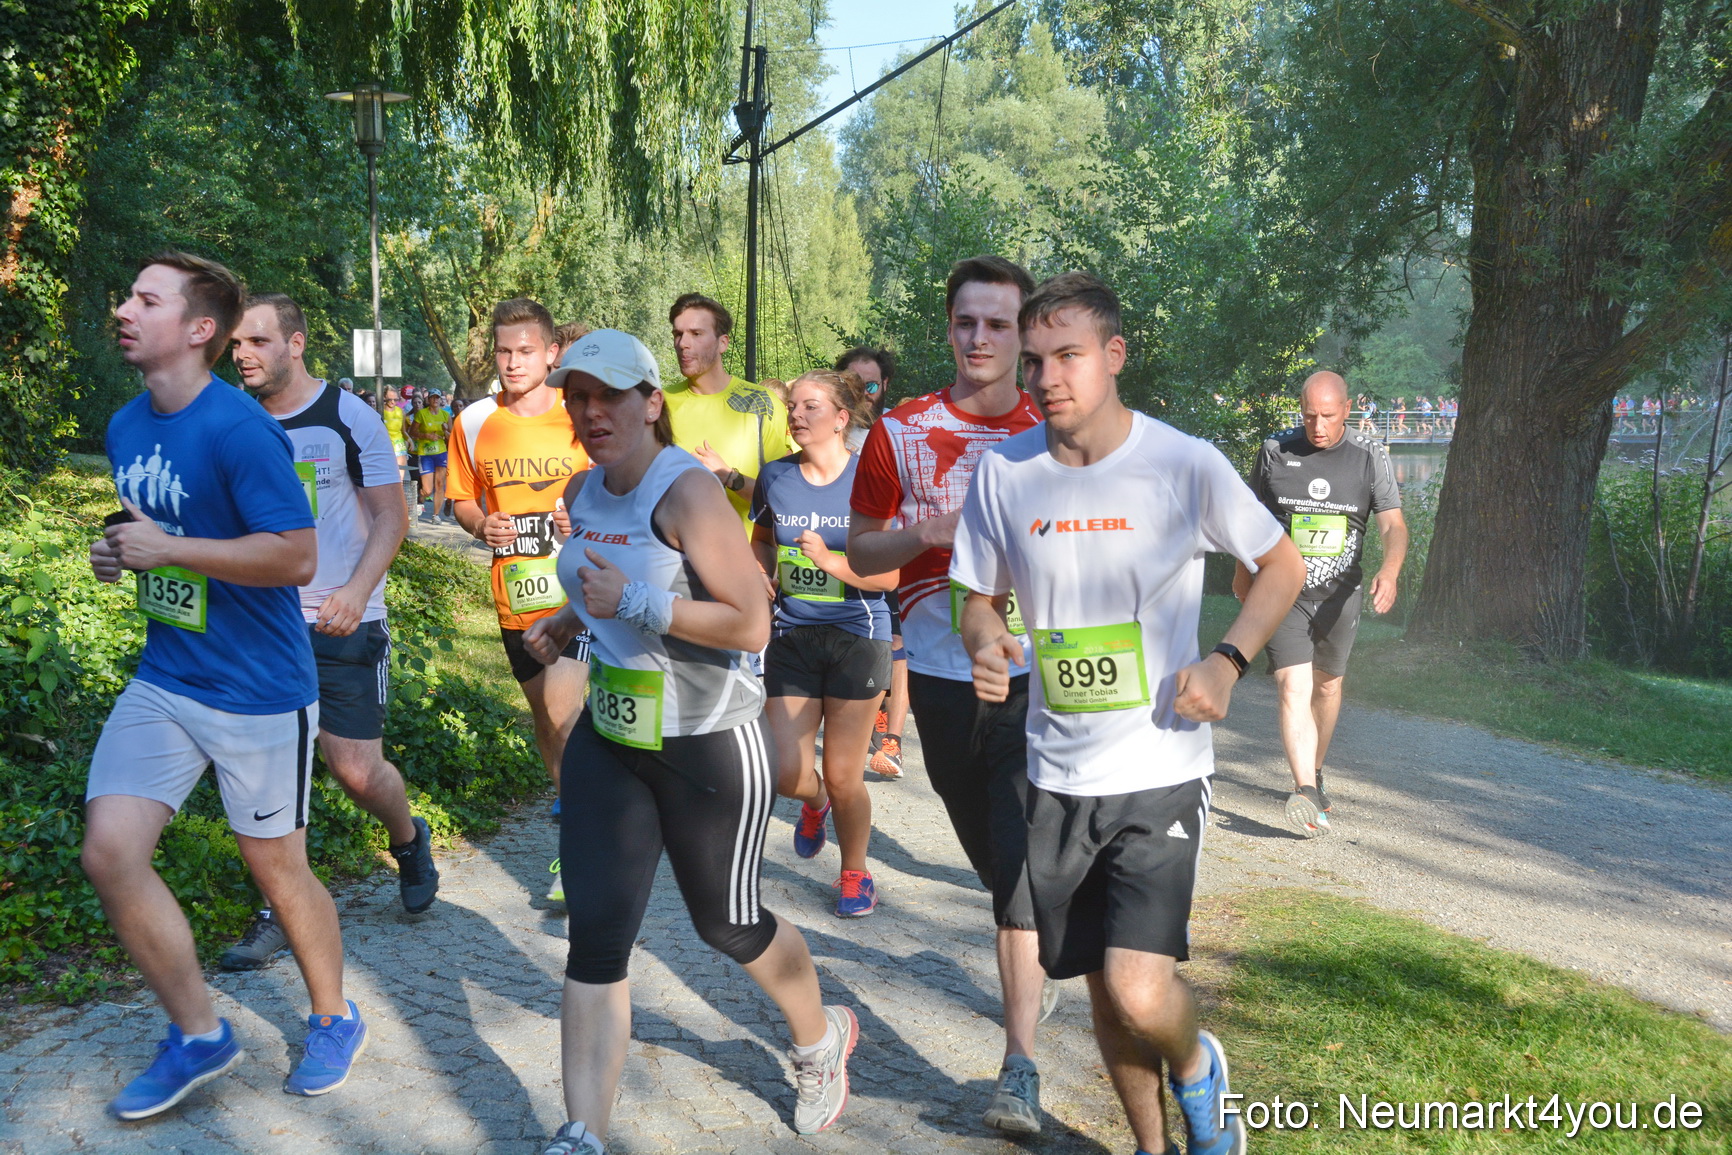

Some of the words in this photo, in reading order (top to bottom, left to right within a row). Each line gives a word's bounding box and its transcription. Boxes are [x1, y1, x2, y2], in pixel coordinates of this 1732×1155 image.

[494, 457, 573, 478] WINGS
[501, 516, 541, 534] ÄUFT
[776, 514, 809, 527] EURO
[821, 516, 850, 528] POLE
[1056, 518, 1134, 533] KLEBL
[516, 536, 540, 555] UNS
[583, 531, 632, 545] KLEBL
[1309, 529, 1329, 544] 77
[789, 566, 828, 587] 499
[141, 572, 194, 610] 1352
[514, 576, 549, 599] 200
[1057, 656, 1118, 688] 899
[1089, 688, 1119, 697] Tobias
[597, 687, 637, 725] 883
